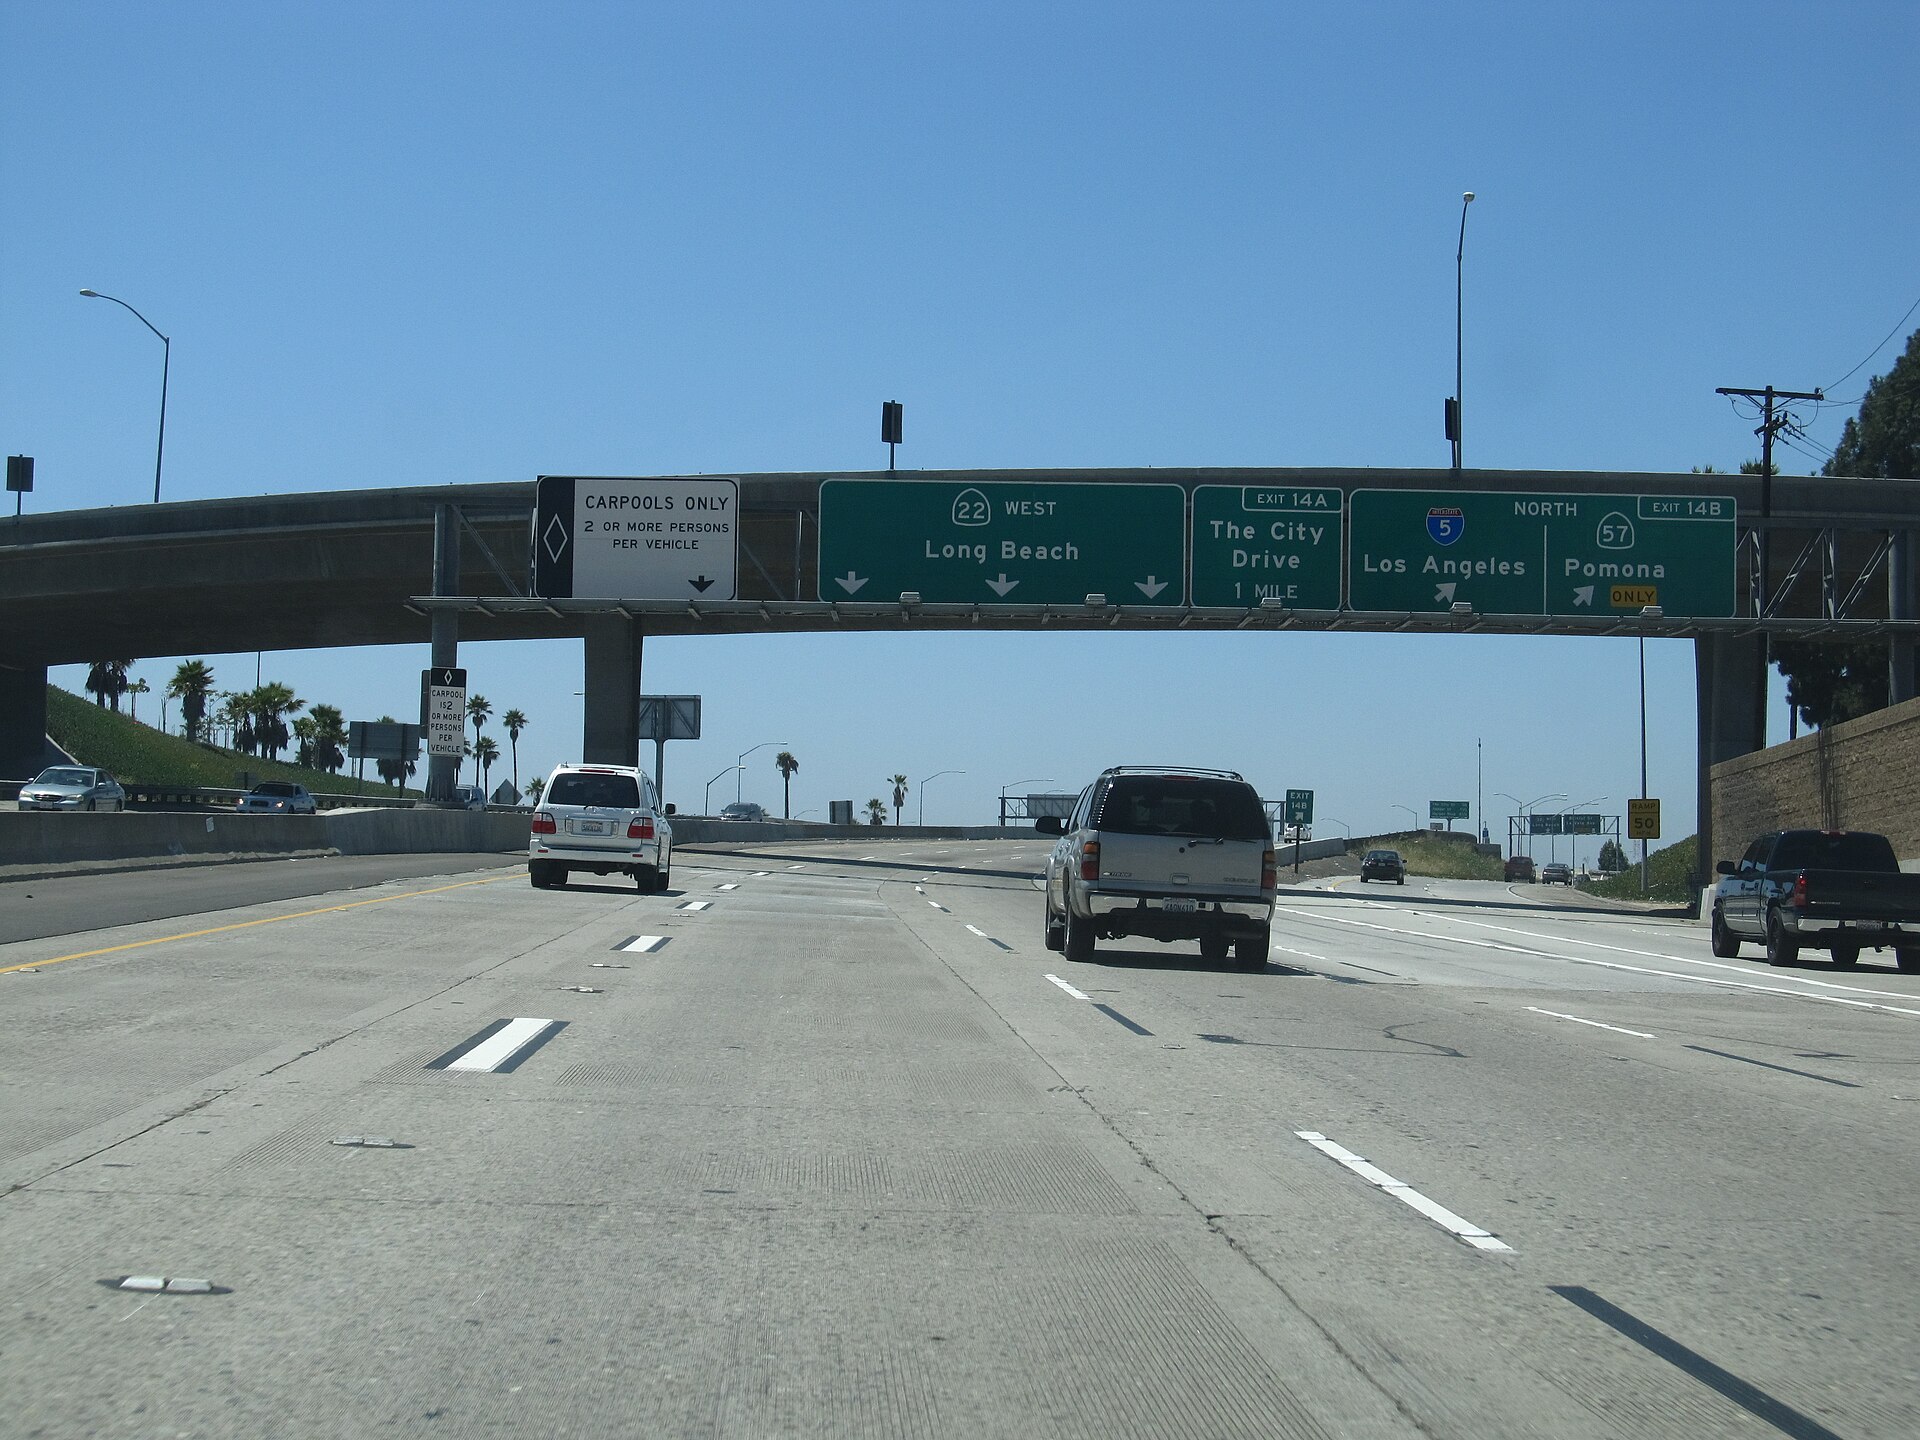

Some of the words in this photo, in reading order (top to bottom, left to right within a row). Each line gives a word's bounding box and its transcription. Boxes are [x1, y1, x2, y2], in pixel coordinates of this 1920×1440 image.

[585, 495, 674, 510] CARPOOLS
[685, 496, 729, 511] ONLY
[1257, 494, 1285, 504] EXIT
[1293, 492, 1328, 507] 14A
[958, 502, 985, 519] 22
[1005, 501, 1057, 516] WEST
[1514, 501, 1577, 517] NORTH
[1653, 502, 1680, 513] EXIT
[1687, 501, 1721, 516] 14B
[584, 521, 594, 532] 2
[603, 522, 620, 532] OR
[627, 522, 663, 532] MORE
[669, 523, 729, 533] PERSONS
[1210, 520, 1256, 540] The
[1270, 521, 1324, 546] City
[1439, 519, 1451, 536] 5
[1602, 525, 1628, 543] 57
[613, 539, 638, 549] PER
[646, 540, 699, 550] VEHICLE
[925, 540, 987, 564] Long
[1001, 540, 1079, 561] Beach
[1232, 549, 1301, 569] Drive
[1364, 554, 1406, 573] Los
[1422, 555, 1526, 580] Angeles
[1565, 558, 1665, 578] Pomona
[1234, 582, 1241, 599] 1
[1255, 584, 1298, 599] MILE
[1612, 590, 1655, 603] ONLY
[431, 689, 464, 699] CARPOOL
[440, 701, 446, 709] IS
[446, 700, 453, 710] 2
[431, 712, 441, 720] OR
[442, 713, 462, 721] MORE
[430, 723, 462, 732] PERSONS
[431, 744, 460, 753] VEHICLE
[1291, 801, 1307, 809] 14B
[1631, 802, 1656, 810] RAMP
[1634, 817, 1654, 829] 50
